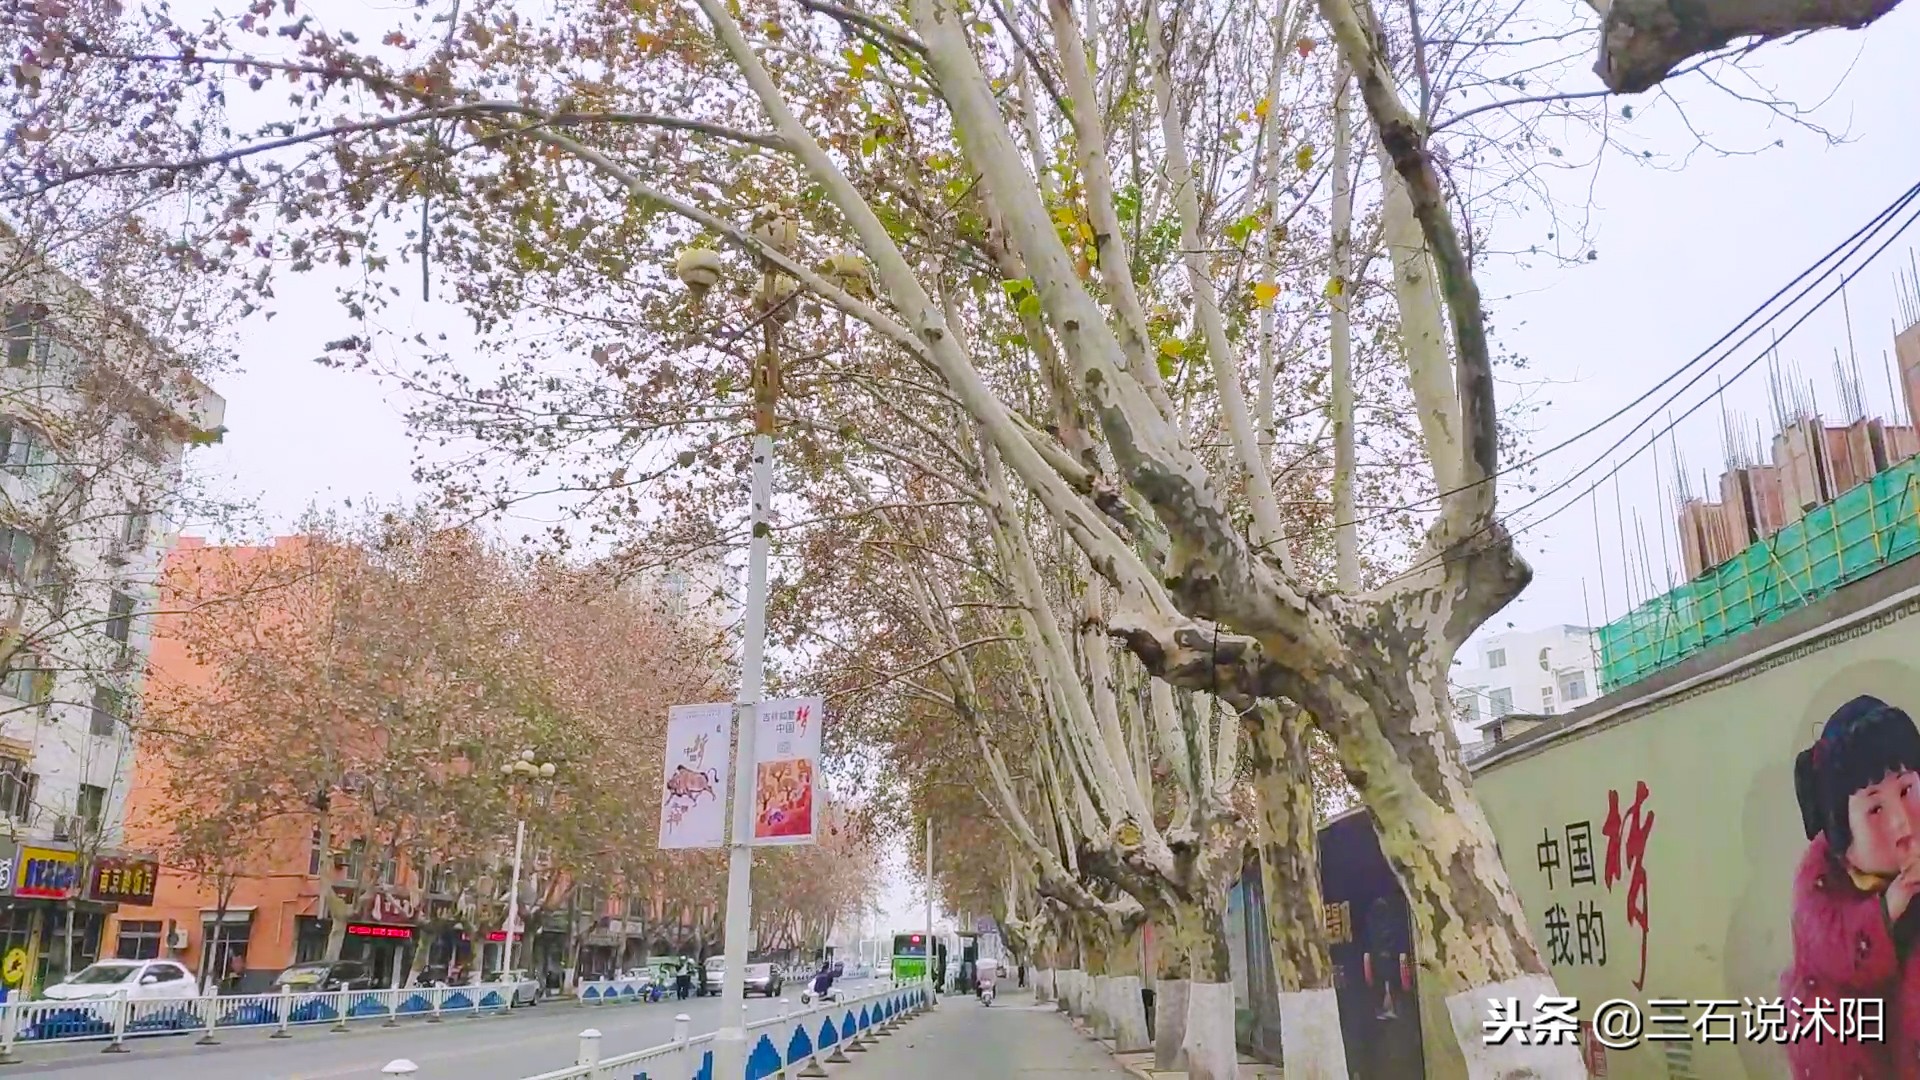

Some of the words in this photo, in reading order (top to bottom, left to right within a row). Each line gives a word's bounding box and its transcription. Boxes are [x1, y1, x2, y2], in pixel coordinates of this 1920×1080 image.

[1536, 820, 1597, 891] 中国
[1602, 780, 1655, 992] 梦
[1544, 899, 1607, 967] 我的
